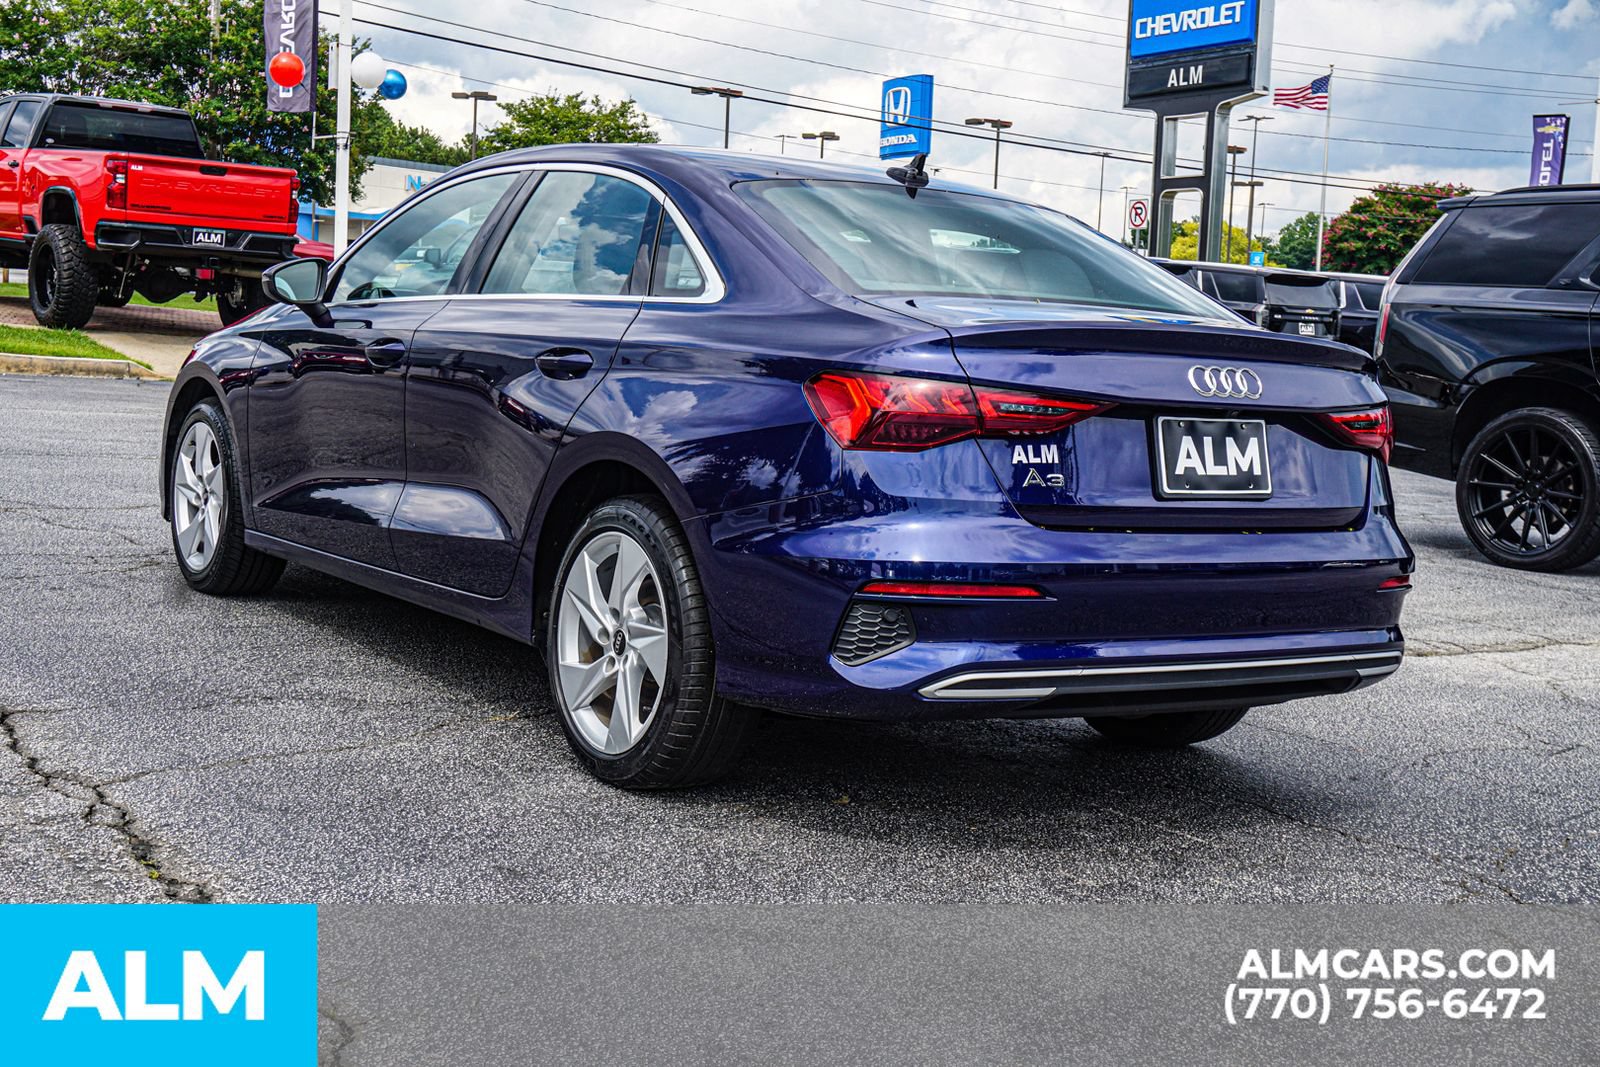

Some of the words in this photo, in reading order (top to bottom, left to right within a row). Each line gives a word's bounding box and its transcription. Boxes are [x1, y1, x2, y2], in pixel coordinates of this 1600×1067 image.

[1135, 1, 1245, 39] CHEVROLET
[1167, 65, 1203, 88] ALM
[880, 134, 917, 147] HONDA
[140, 178, 281, 198] CHEVROLET
[196, 232, 221, 243] ALM
[1012, 444, 1059, 464] ALM
[1174, 436, 1261, 475] ALM
[1022, 467, 1065, 487] A3
